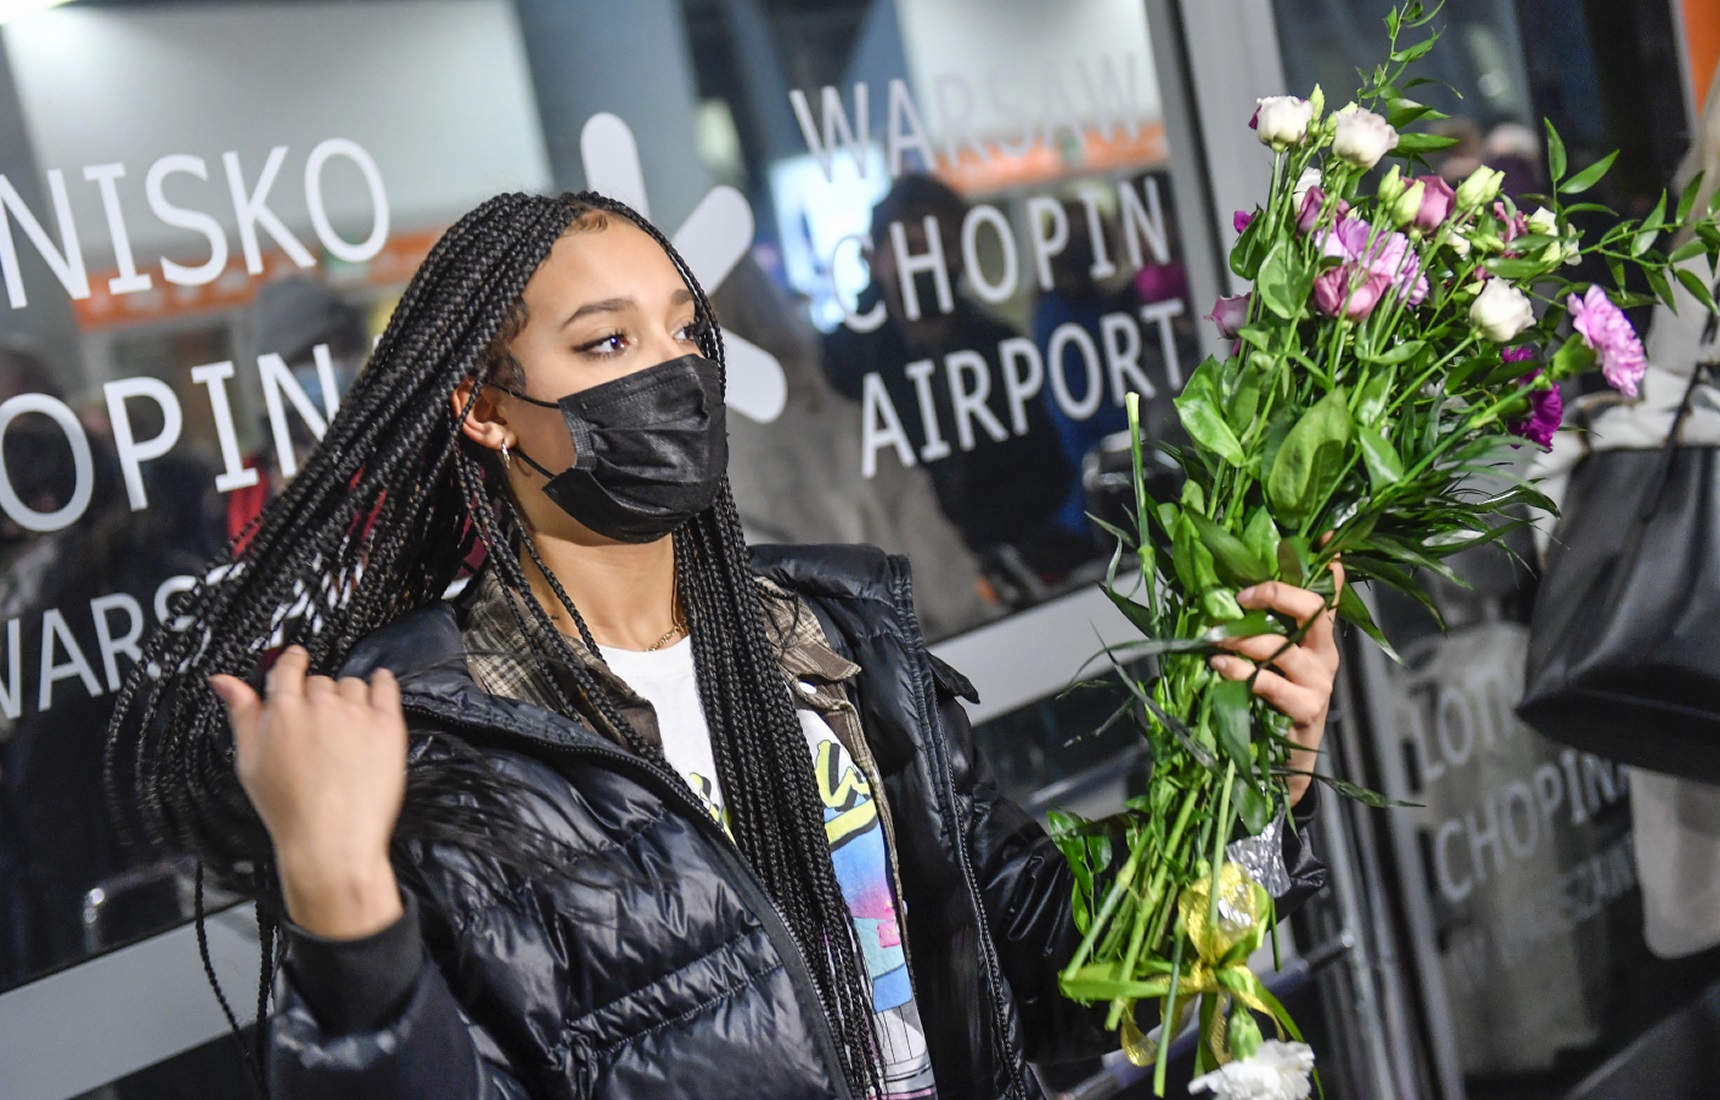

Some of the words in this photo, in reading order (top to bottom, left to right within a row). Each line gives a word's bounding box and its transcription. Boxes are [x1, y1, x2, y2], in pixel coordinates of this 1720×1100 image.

[789, 50, 1140, 184] WARSAW
[0, 138, 390, 309] NISKO
[832, 176, 1170, 333] CHOPIN
[0, 334, 381, 532] OPIN
[861, 299, 1184, 478] AIRPORT
